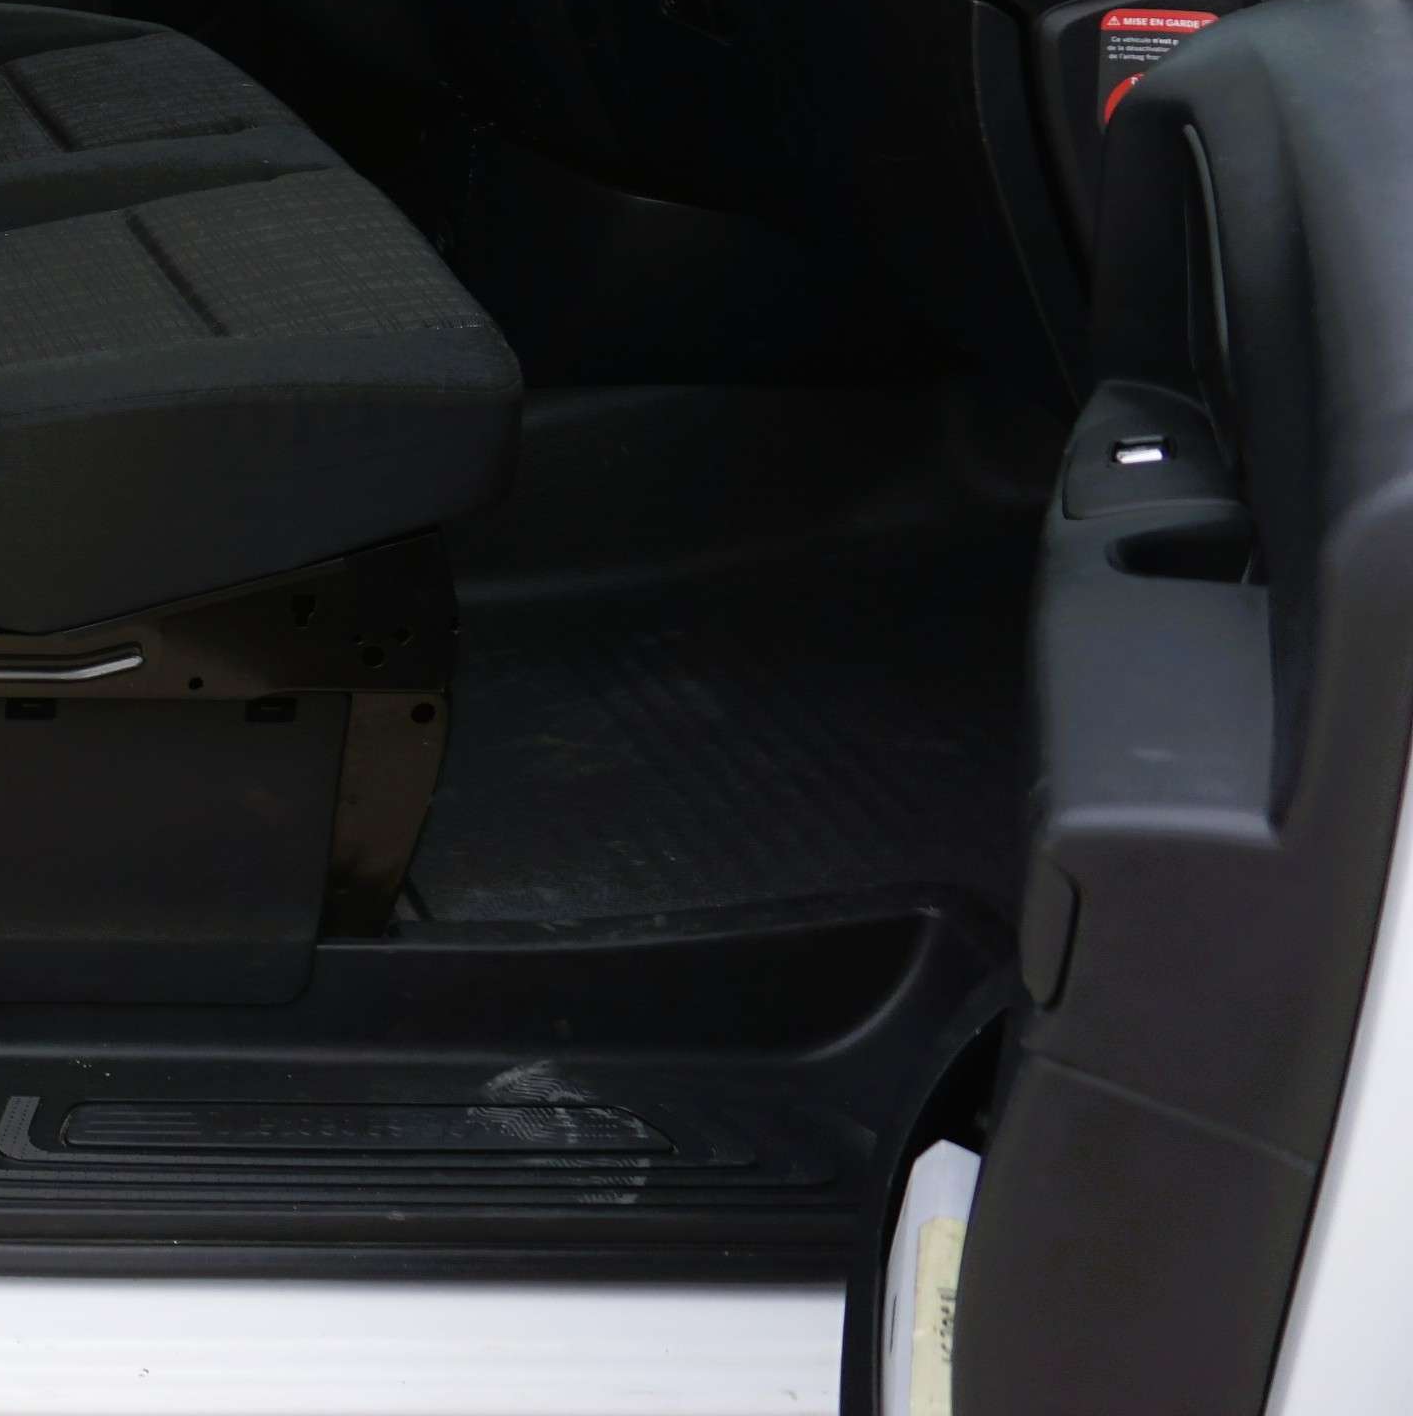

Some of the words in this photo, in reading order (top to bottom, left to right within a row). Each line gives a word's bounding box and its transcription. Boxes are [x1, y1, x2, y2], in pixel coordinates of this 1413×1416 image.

[1123, 17, 1148, 26] MISE
[1149, 18, 1164, 26] EN
[1165, 19, 1200, 29] GARDE
